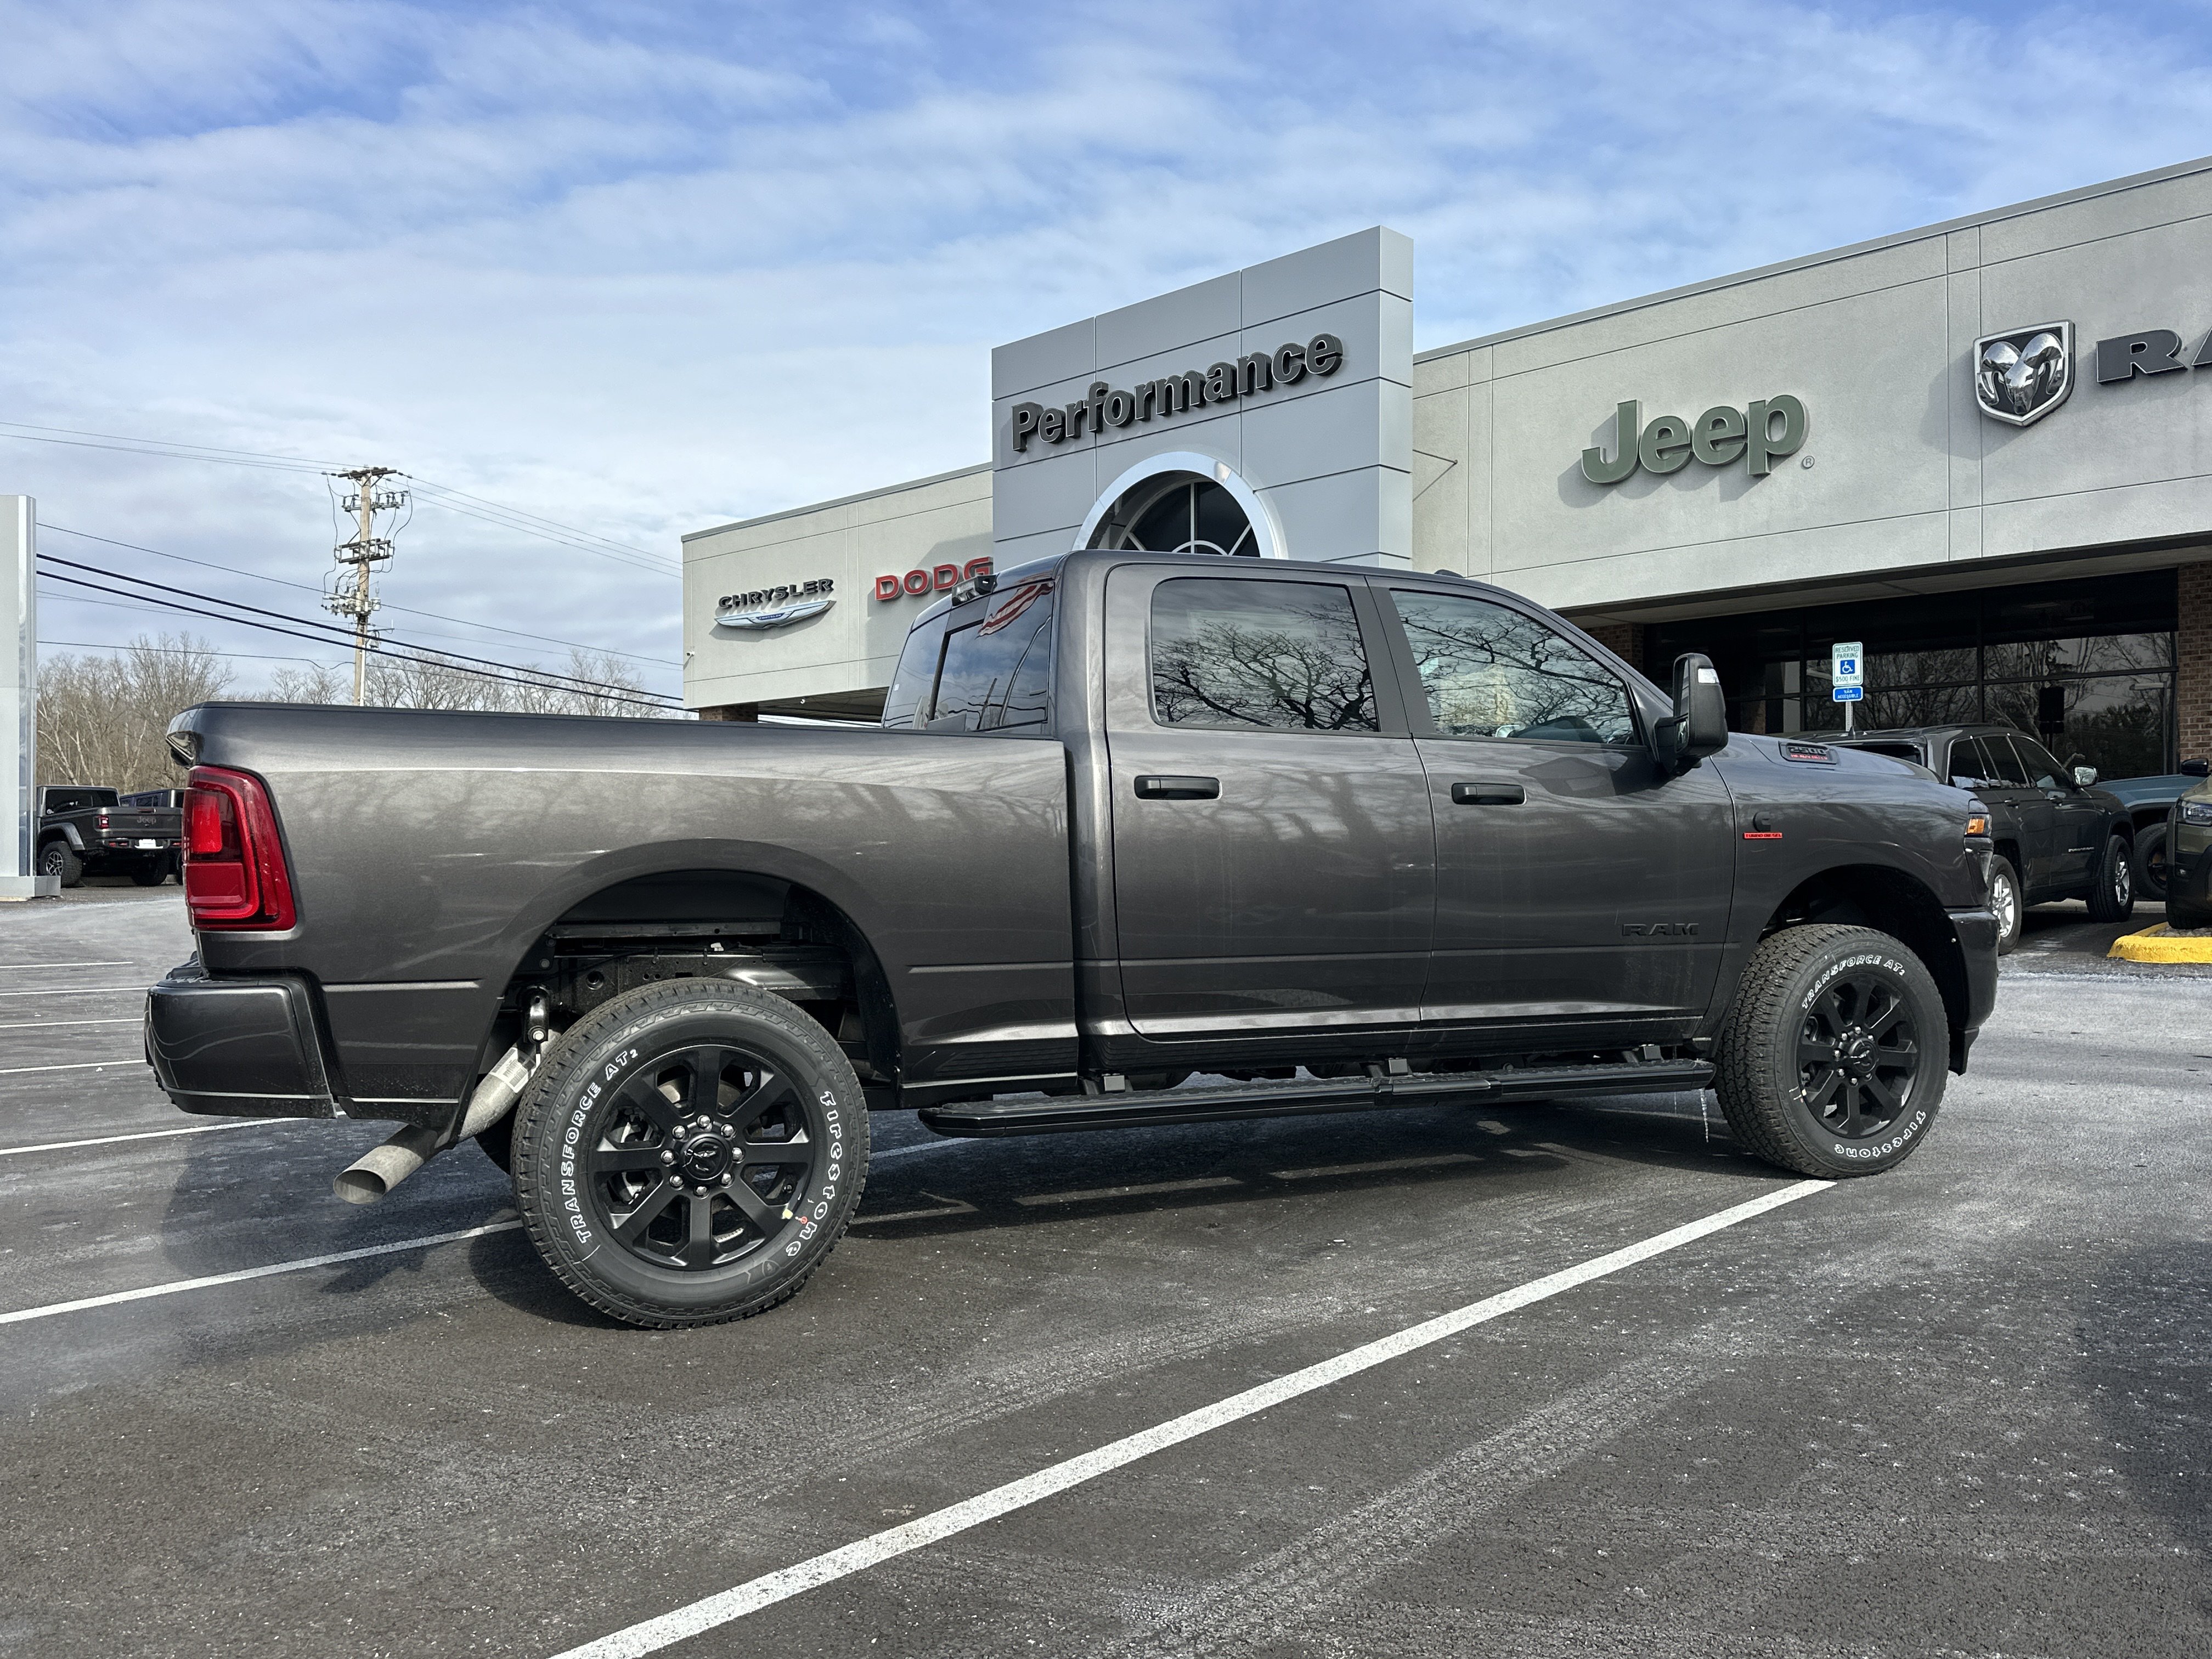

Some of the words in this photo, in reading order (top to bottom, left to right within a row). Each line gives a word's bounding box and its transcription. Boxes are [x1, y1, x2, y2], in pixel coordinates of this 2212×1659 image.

[1011, 333, 1343, 452] Performance
[1582, 394, 1809, 483] Jeep
[718, 578, 834, 609] CHRYSLER
[1790, 747, 1827, 755] 2500
[137, 816, 157, 825] Jeep
[1622, 923, 1699, 936] RAM
[1802, 955, 1882, 1009] TRANSFORCE
[1835, 1110, 1927, 1158] Firestone
[561, 1082, 601, 1244] TRANSFORCE
[785, 1091, 842, 1257] Firestone
